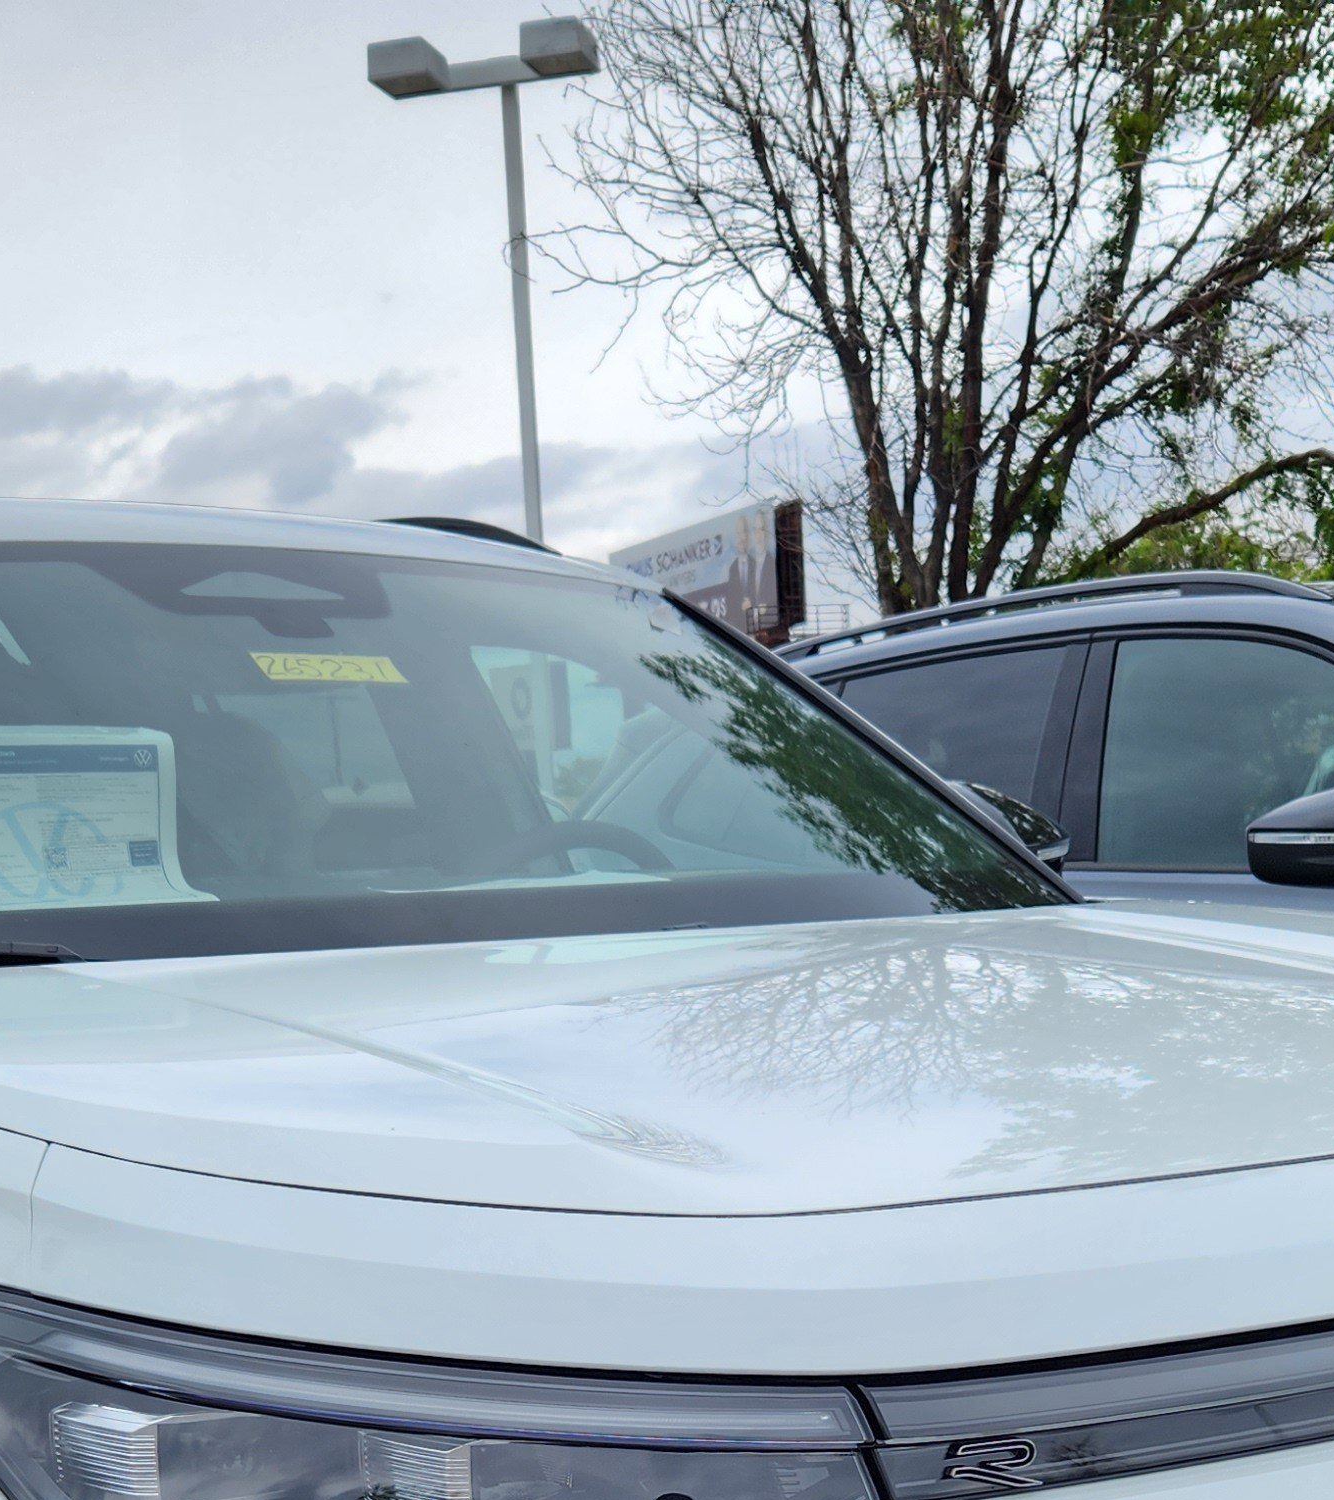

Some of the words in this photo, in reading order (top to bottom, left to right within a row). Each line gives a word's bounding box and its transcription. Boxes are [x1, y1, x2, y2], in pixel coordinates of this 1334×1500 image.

[656, 537, 712, 574] SCHANKER
[255, 655, 389, 681] 265231
[943, 1438, 1044, 1488] R
